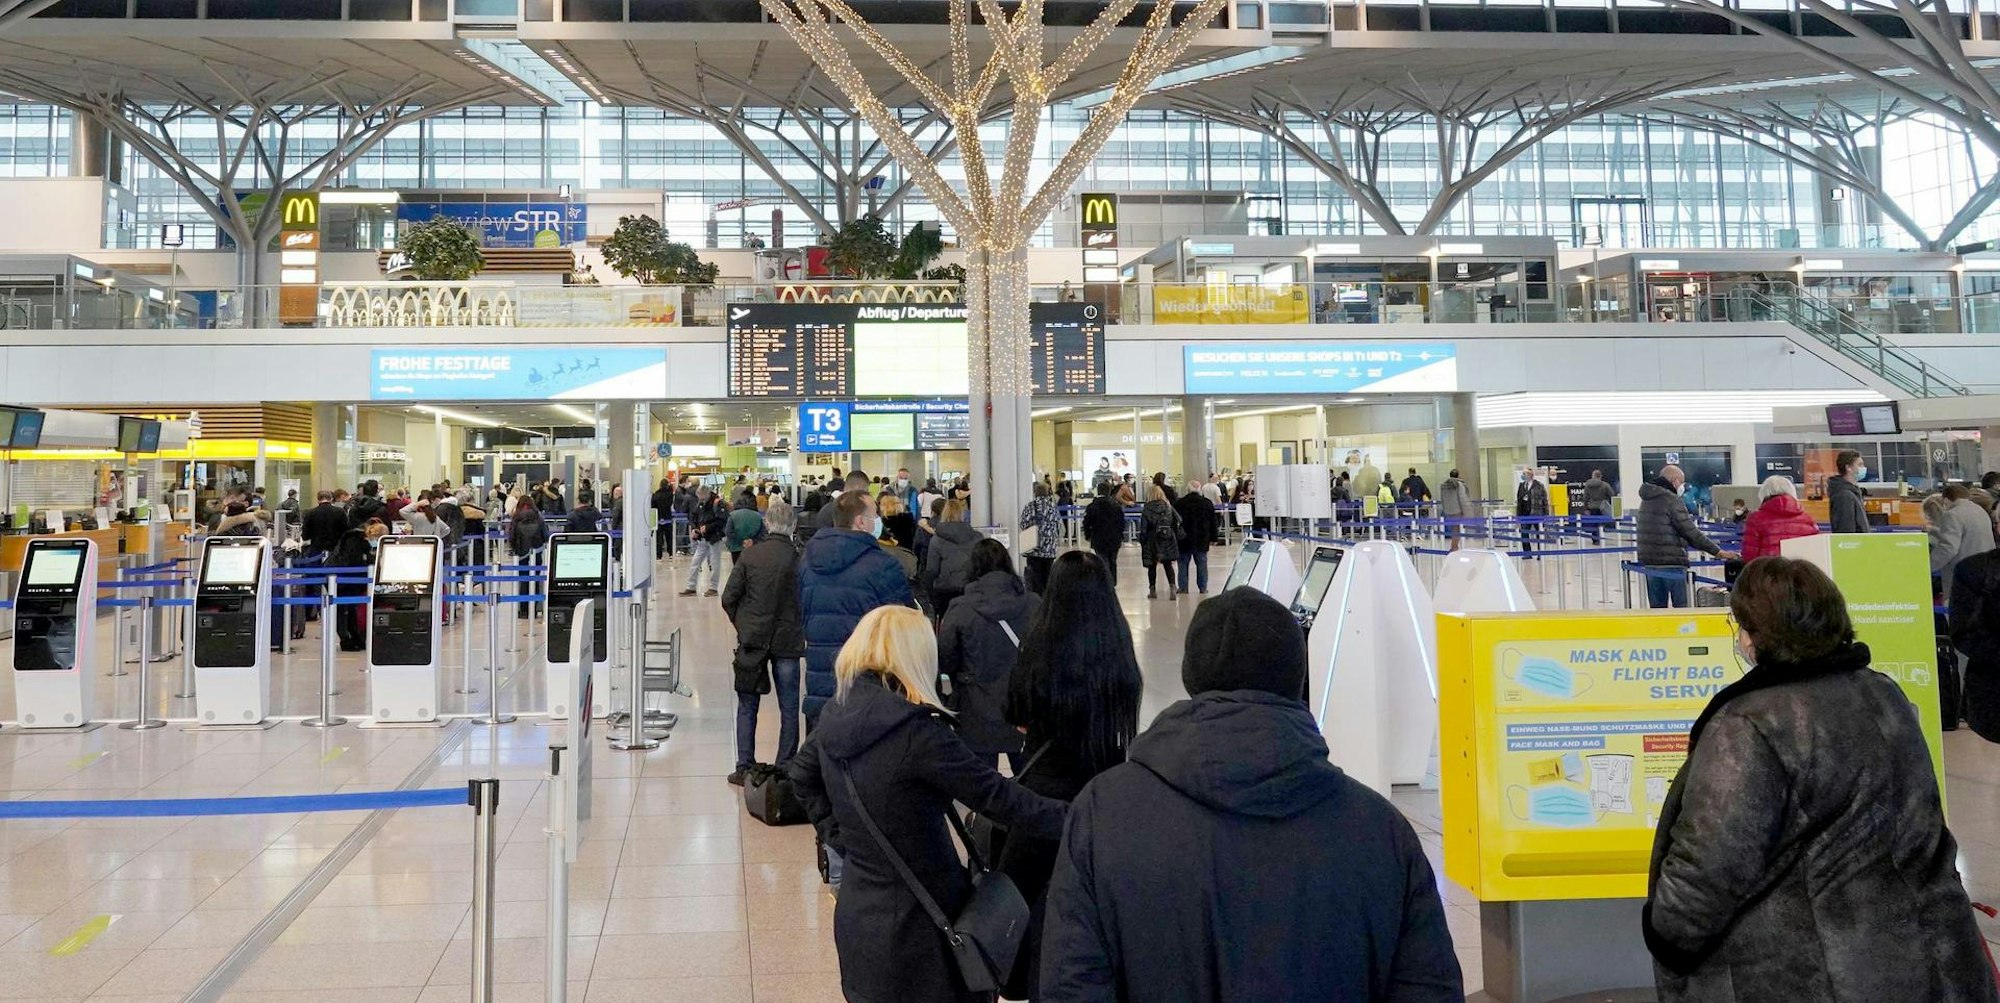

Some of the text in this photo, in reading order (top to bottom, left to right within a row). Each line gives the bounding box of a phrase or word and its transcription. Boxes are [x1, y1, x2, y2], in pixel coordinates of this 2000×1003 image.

[1160, 300, 1207, 313] Wieder
[857, 307, 899, 320] Abflug
[380, 356, 511, 370] FROHE FESTTAGE
[925, 403, 953, 411] Security
[808, 408, 842, 432] T3
[515, 453, 546, 461] CODE
[1570, 649, 1667, 663] MASK AND
[1613, 666, 1724, 681] FLIGHT BAG
[1511, 726, 1546, 734] EINWEG
[1549, 724, 1599, 733] NASE-MUND
[1601, 723, 1665, 732] SCHUTZMASKE
[1510, 739, 1601, 750] FACE MASK AND BAG
